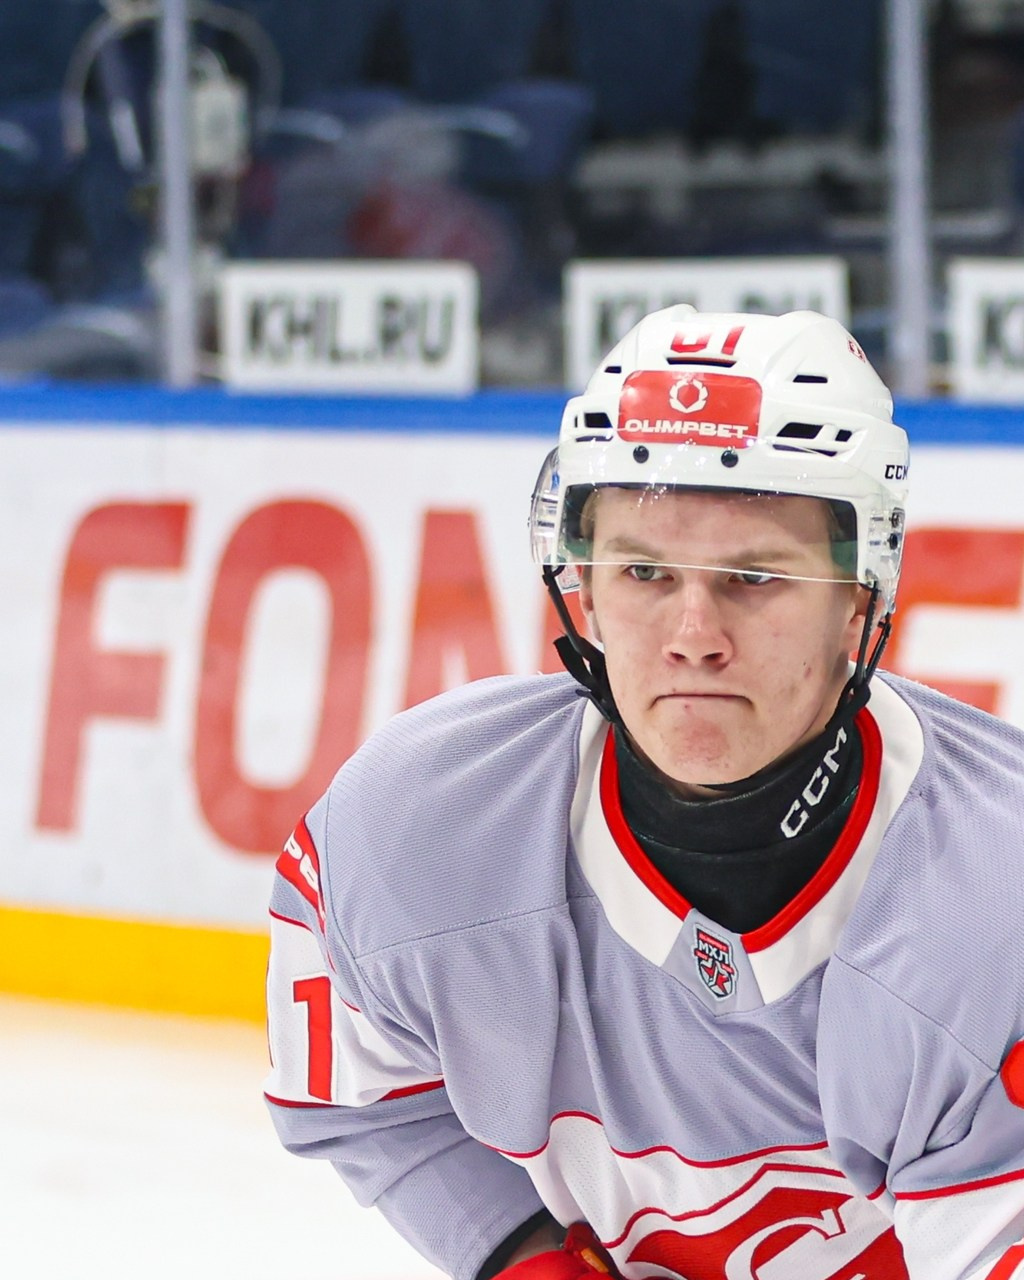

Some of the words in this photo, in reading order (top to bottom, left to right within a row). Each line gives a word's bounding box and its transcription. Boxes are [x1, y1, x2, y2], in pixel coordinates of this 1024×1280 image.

[247, 291, 456, 364] KHL.RU
[625, 419, 748, 439] OLIMPBET
[780, 727, 848, 838] CCM
[698, 940, 729, 965] МХЛ
